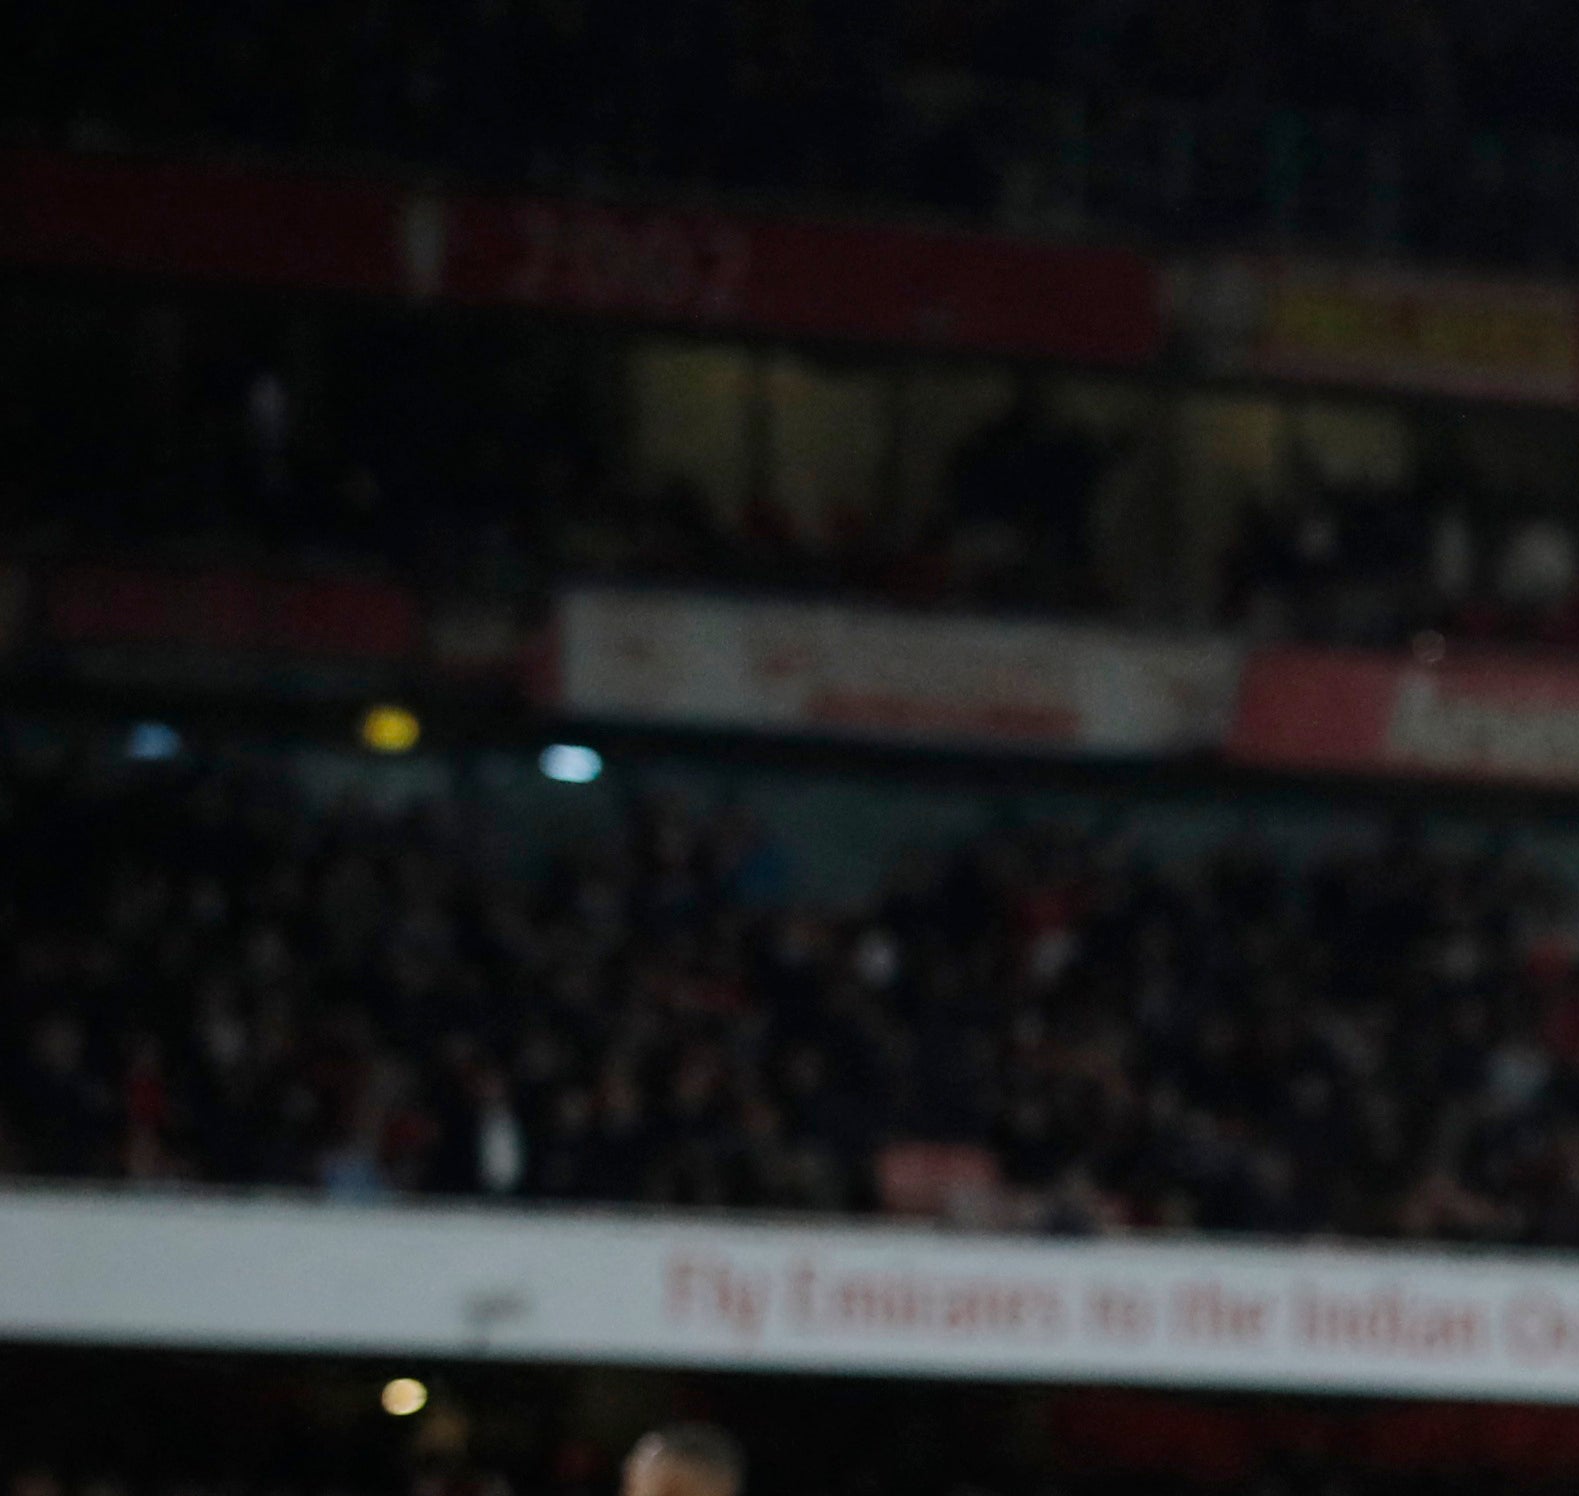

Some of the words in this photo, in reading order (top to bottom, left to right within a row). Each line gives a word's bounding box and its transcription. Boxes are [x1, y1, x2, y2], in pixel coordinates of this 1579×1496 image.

[664, 1256, 765, 1350] Fly
[784, 1264, 1064, 1338] Emirates
[1086, 1284, 1152, 1340] to
[1170, 1281, 1269, 1346] the
[1296, 1283, 1484, 1356] Indian
